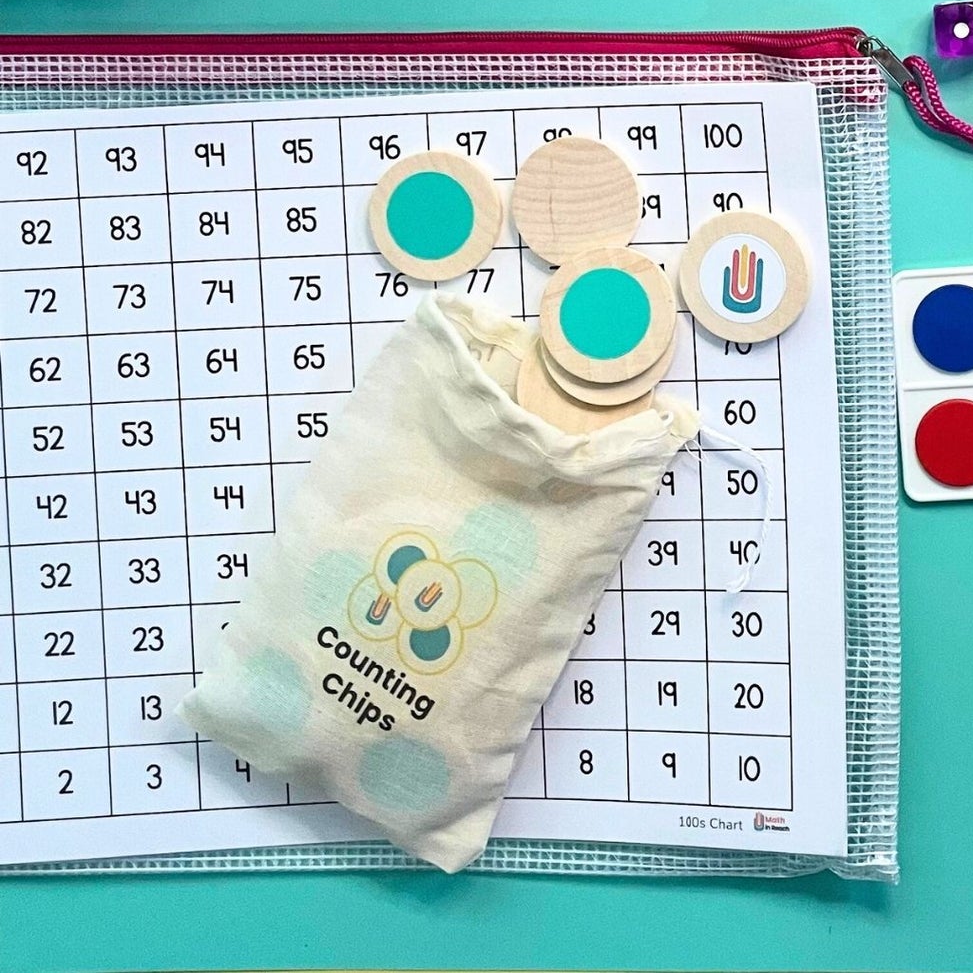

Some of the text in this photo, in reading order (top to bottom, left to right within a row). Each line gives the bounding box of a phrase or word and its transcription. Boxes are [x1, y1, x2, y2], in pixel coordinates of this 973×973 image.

[16, 150, 49, 176] 92
[105, 146, 137, 172] 93
[194, 142, 226, 168] 94
[282, 138, 314, 164] 95
[369, 134, 401, 160] 96
[455, 130, 487, 156] 97
[627, 125, 657, 151] 99
[703, 123, 743, 149] 100
[20, 219, 53, 245] 82
[109, 215, 142, 241] 83
[199, 211, 230, 237] 84
[286, 206, 317, 233] 85
[24, 268, 495, 314] 72 73 74 75 76 77
[29, 356, 62, 383] 62
[117, 352, 150, 379] 63
[206, 348, 238, 374] 64
[293, 344, 326, 370] 65
[32, 399, 756, 452] 52 53 54 55 60
[36, 469, 759, 520] 42 43 44 9 50
[40, 540, 761, 589] 32 33 34 39 40
[44, 630, 76, 657] 22
[132, 626, 164, 652] 23
[650, 610, 680, 636] 29
[731, 611, 763, 638] 30
[316, 626, 436, 721] Counting
[52, 679, 764, 726] 12 13 18 19 20
[321, 672, 396, 733] Chips
[58, 749, 761, 795] 2 3 4 8 9 10
[679, 815, 743, 831] 100s Chart
[765, 815, 786, 824] Math
